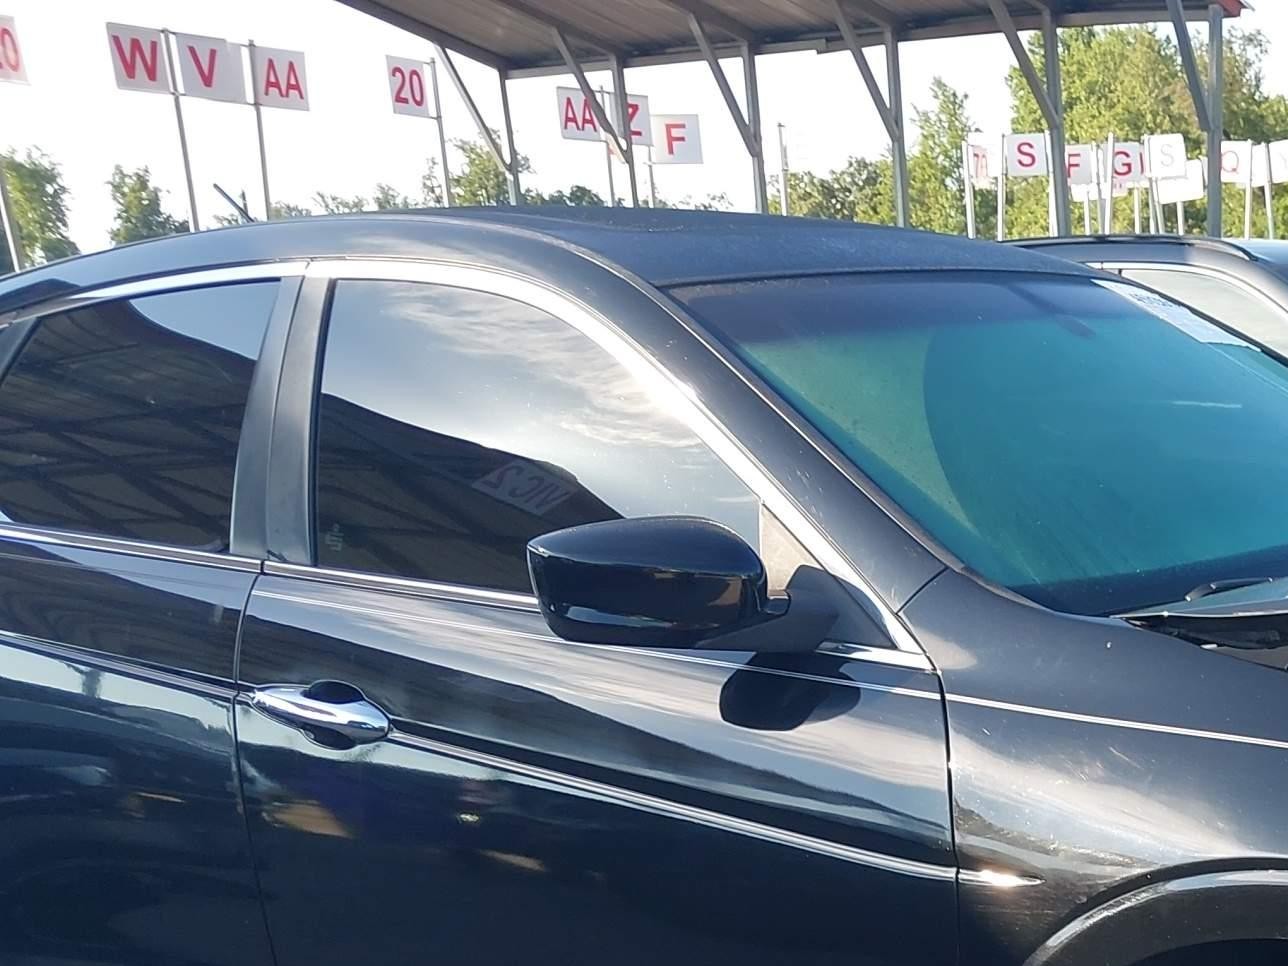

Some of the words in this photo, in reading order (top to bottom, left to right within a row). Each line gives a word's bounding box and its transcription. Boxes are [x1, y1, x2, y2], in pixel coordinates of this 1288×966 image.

[0, 28, 20, 73] 0
[112, 35, 158, 81] W
[187, 46, 217, 88] V
[263, 57, 305, 99] AA
[391, 66, 425, 107] 20
[563, 96, 598, 133] AA
[665, 123, 686, 154] F
[1016, 142, 1036, 168] S
[1160, 143, 1175, 168] S
[1066, 153, 1081, 178] F
[1113, 150, 1132, 176] G
[1222, 150, 1240, 174] Q
